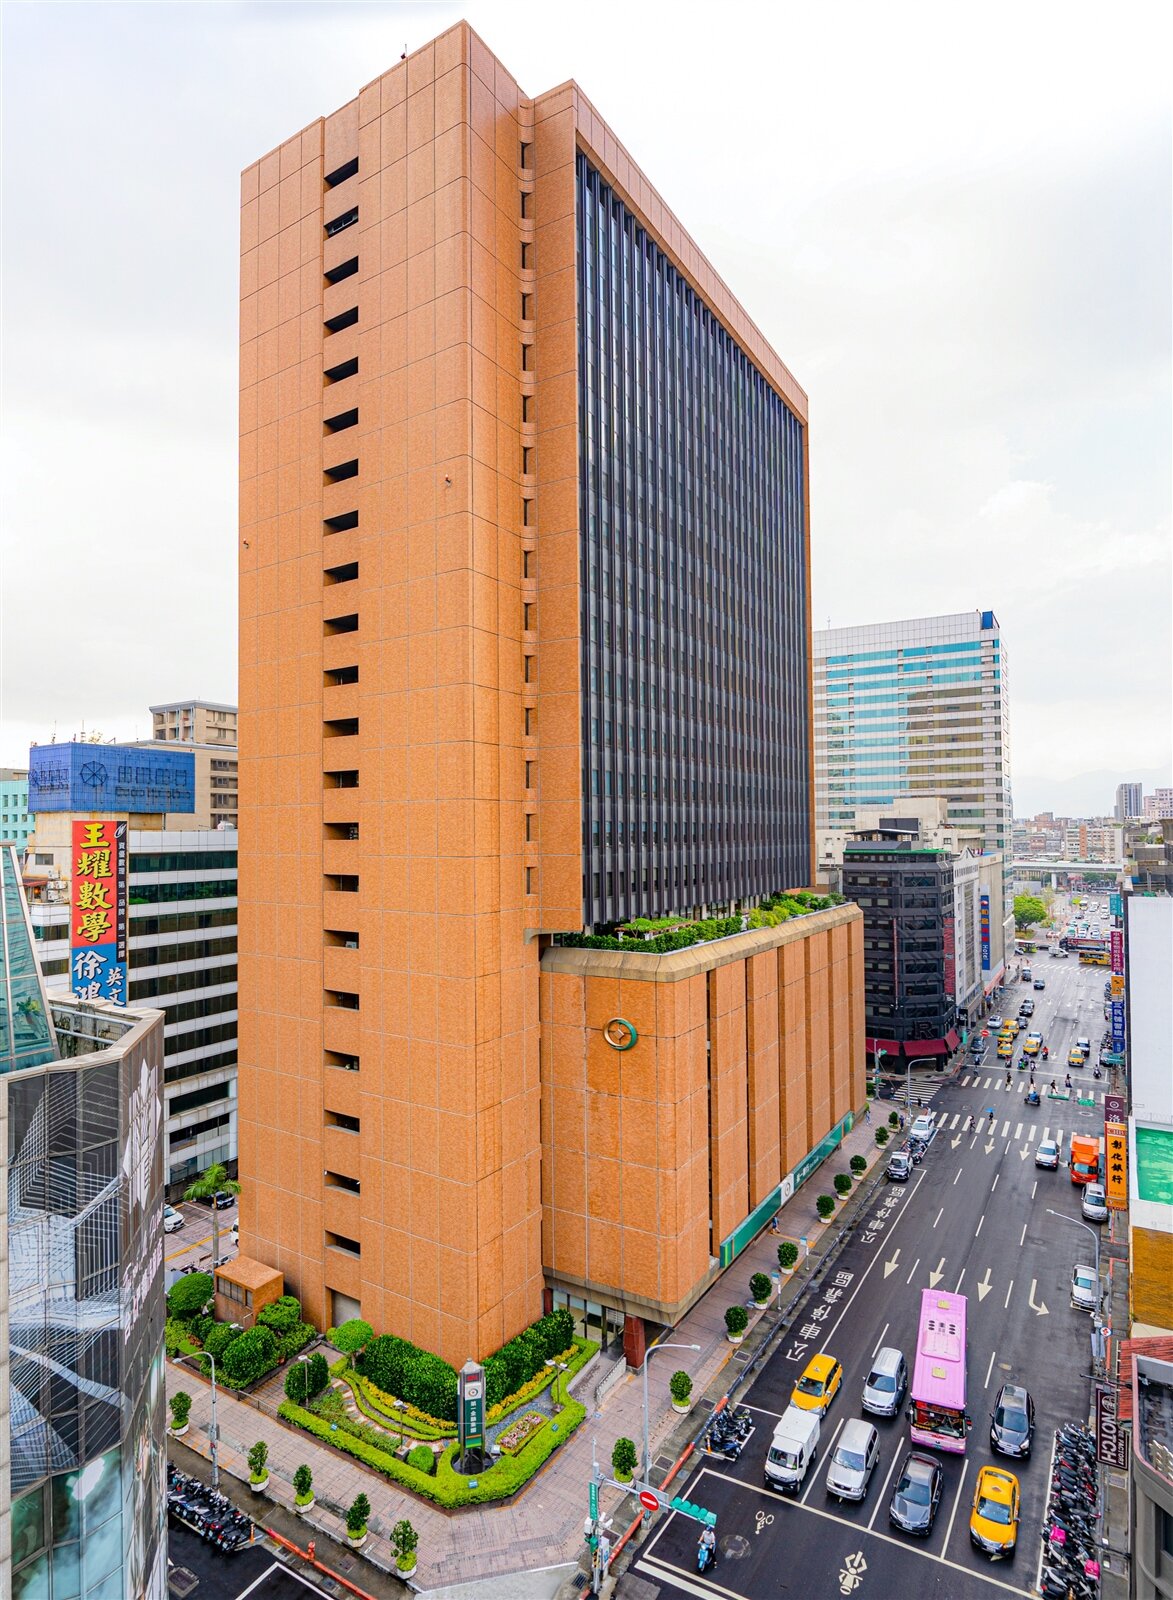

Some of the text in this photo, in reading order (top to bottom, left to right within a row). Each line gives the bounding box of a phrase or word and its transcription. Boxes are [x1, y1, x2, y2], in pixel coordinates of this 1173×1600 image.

[76, 822, 113, 942] 王耀數學
[106, 967, 125, 1005] 英文
[1110, 1140, 1123, 1185] 彰化銀行
[860, 1185, 906, 1244] 公車停靠區
[786, 1271, 854, 1362] 公車停靠區
[1101, 1411, 1117, 1464] NOTCH
